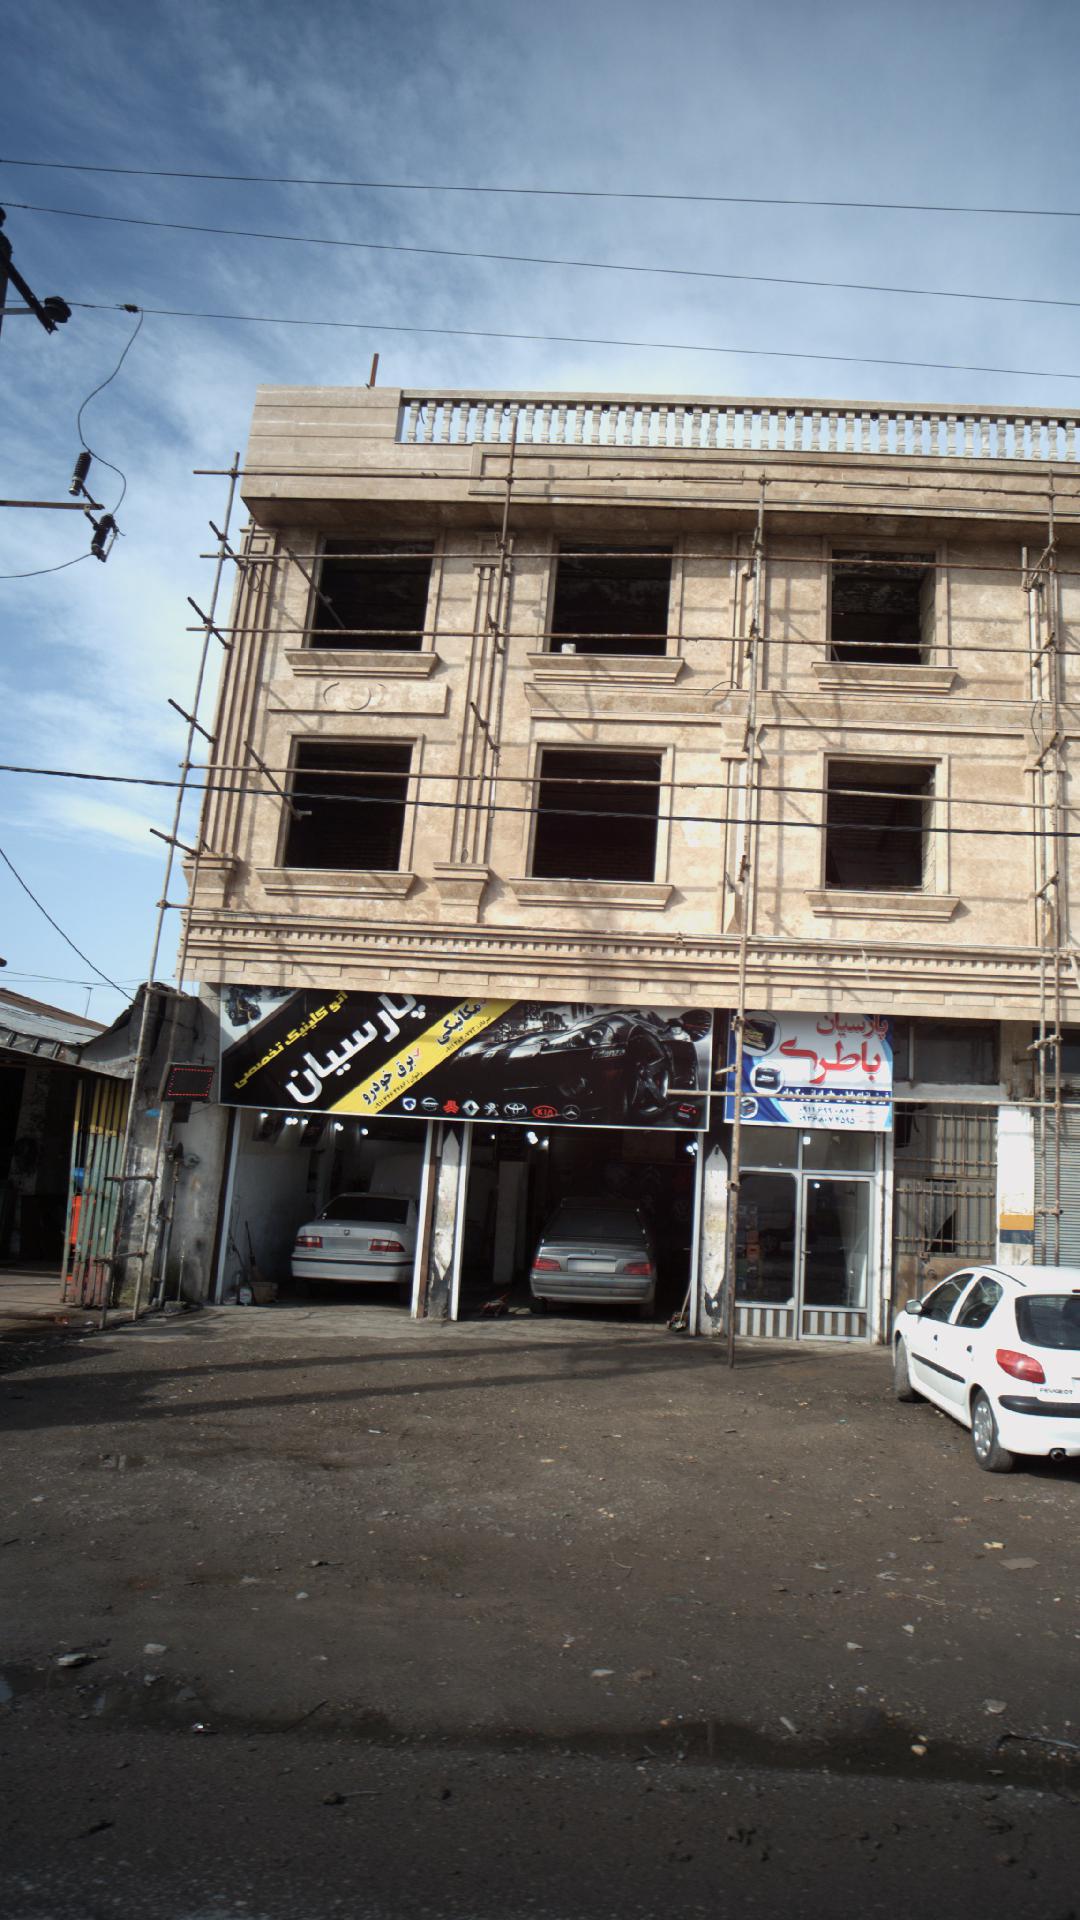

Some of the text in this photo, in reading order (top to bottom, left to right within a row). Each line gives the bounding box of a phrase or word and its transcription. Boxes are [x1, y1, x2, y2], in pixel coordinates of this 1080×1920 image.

[285, 1006, 329, 1046] کلینیک
[437, 1003, 482, 1045] مکانیکی
[816, 1013, 888, 1039] پارسیان
[234, 1042, 285, 1089] تخصصی
[285, 994, 426, 1104] پارسیان
[779, 1037, 882, 1085] باطری
[362, 1055, 416, 1105] برق خودرو
[537, 1108, 553, 1116] KIA
